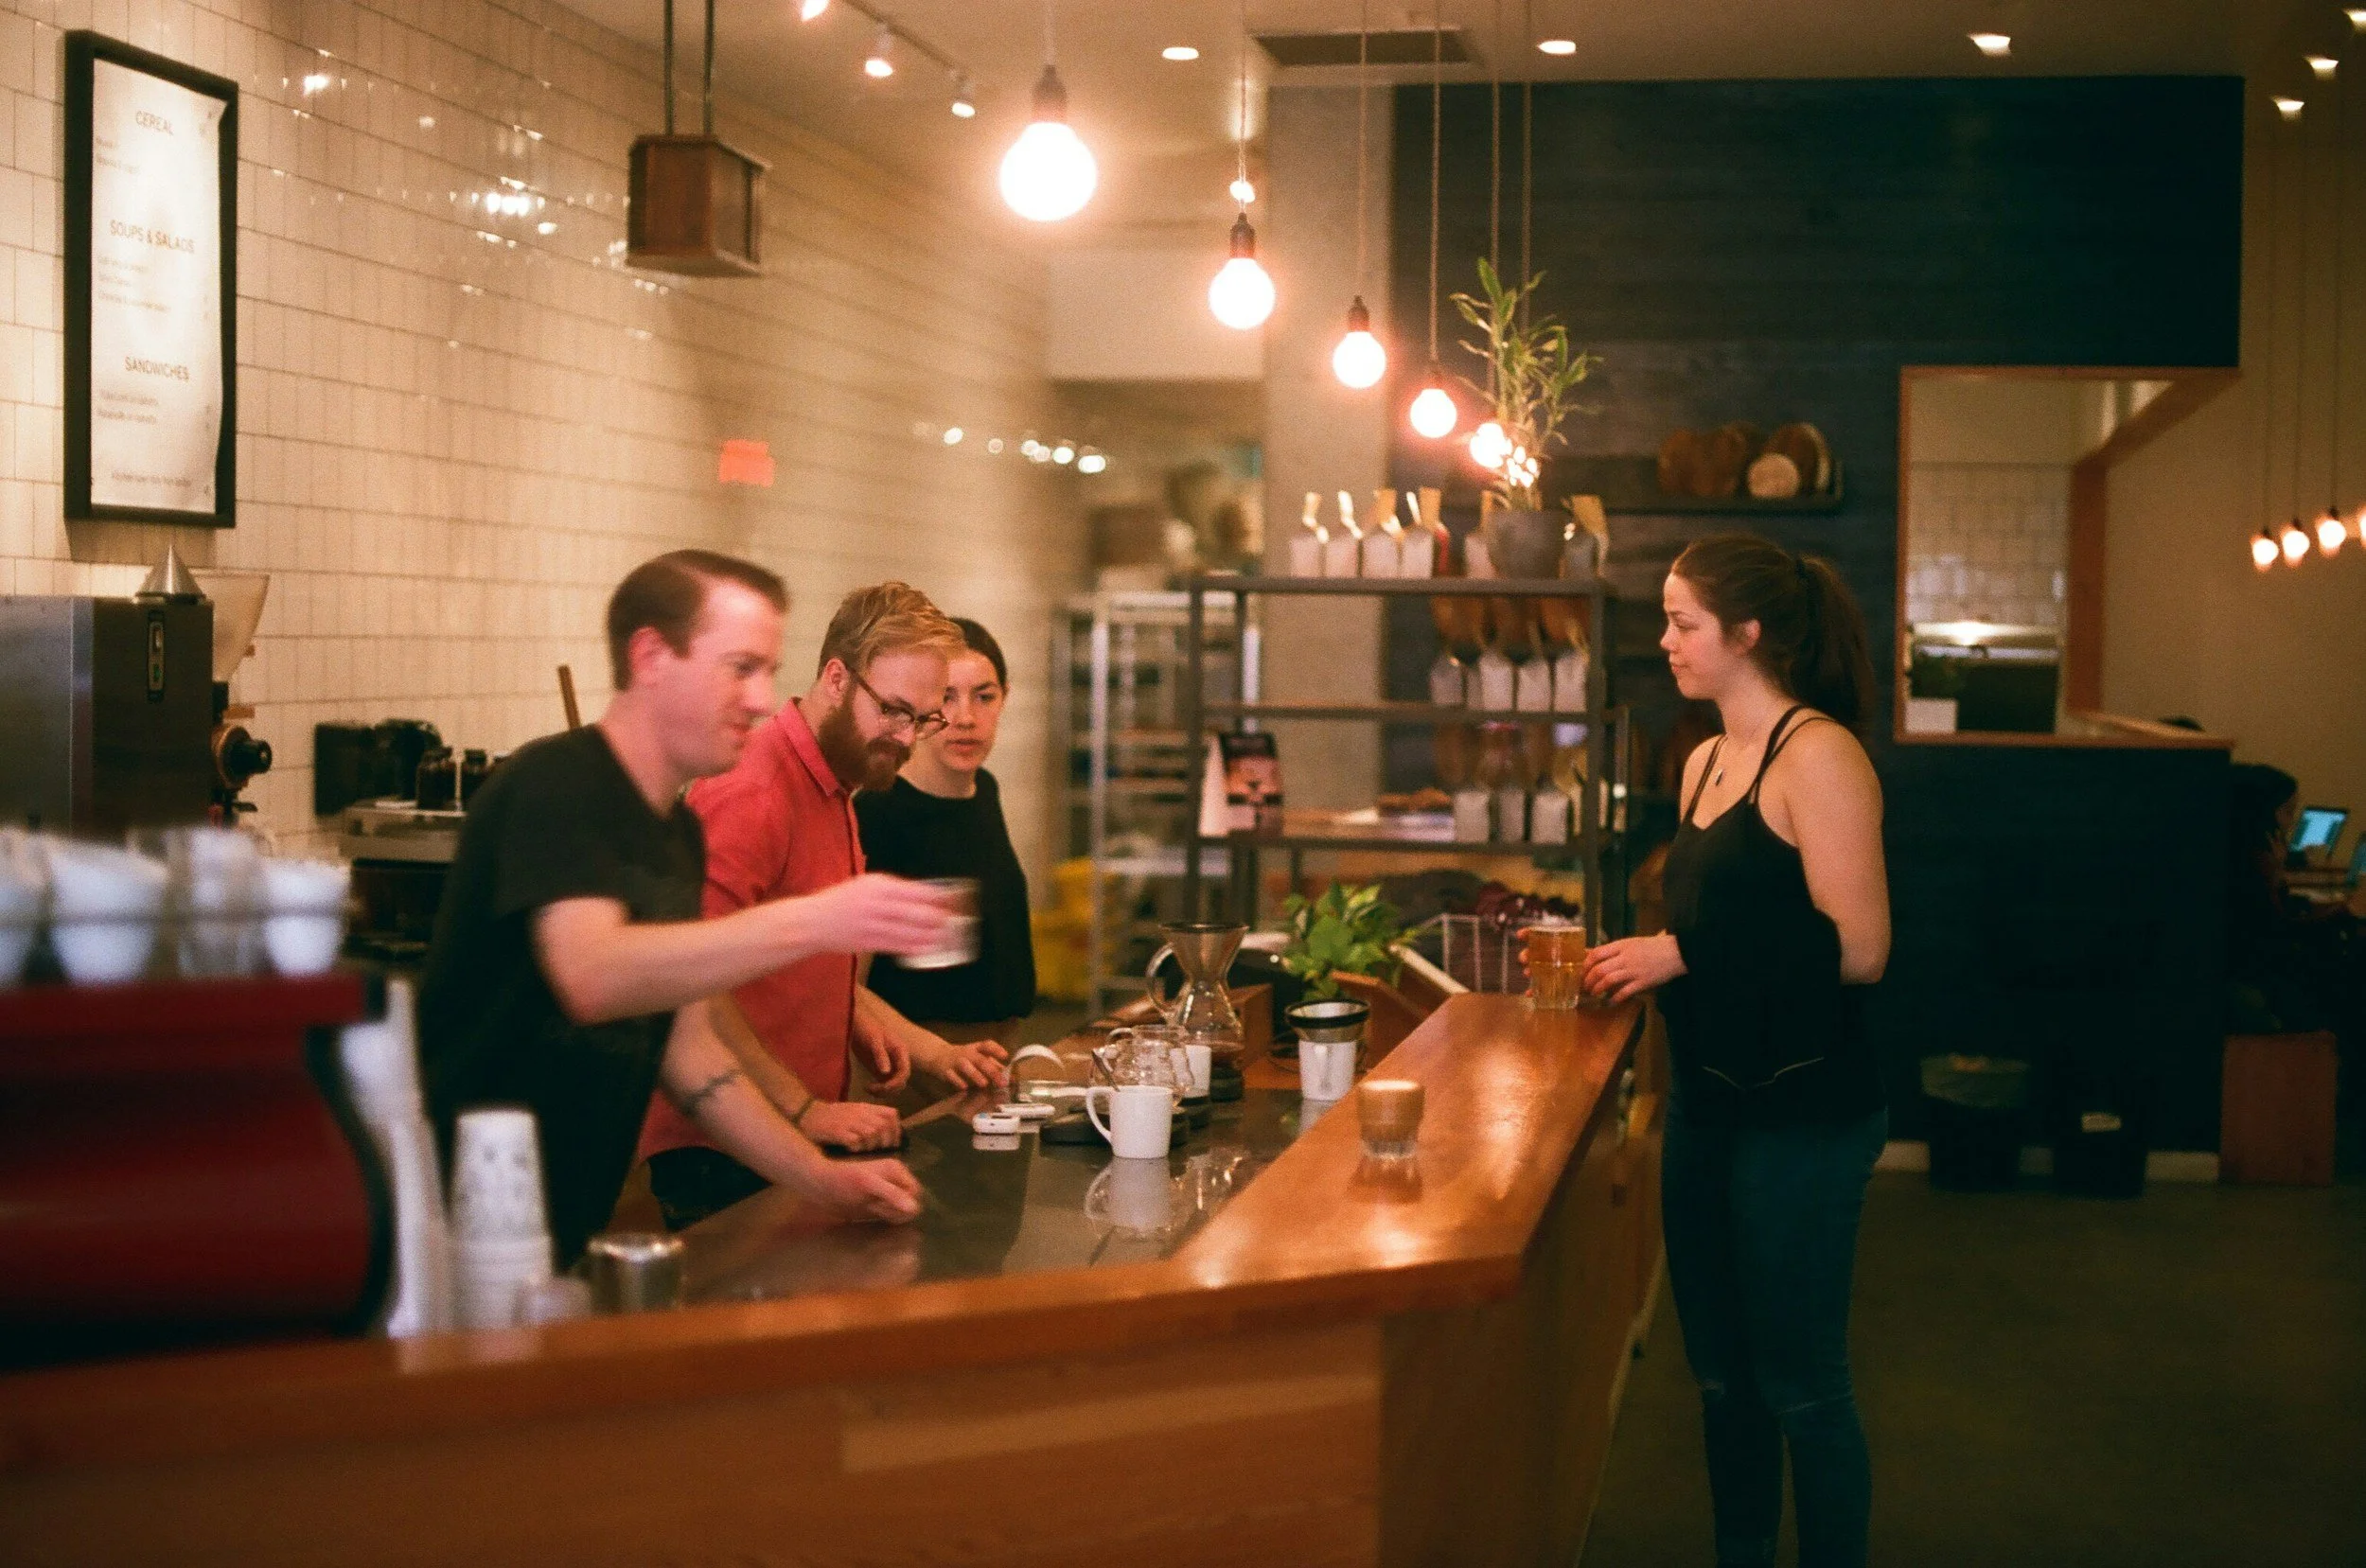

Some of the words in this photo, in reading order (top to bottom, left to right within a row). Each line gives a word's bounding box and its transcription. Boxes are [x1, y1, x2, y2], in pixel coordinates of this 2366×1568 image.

[135, 110, 174, 135] CEREAL
[110, 219, 143, 241] SOUPS
[155, 231, 195, 254] SALADS
[124, 356, 189, 382] SANDWICHES
